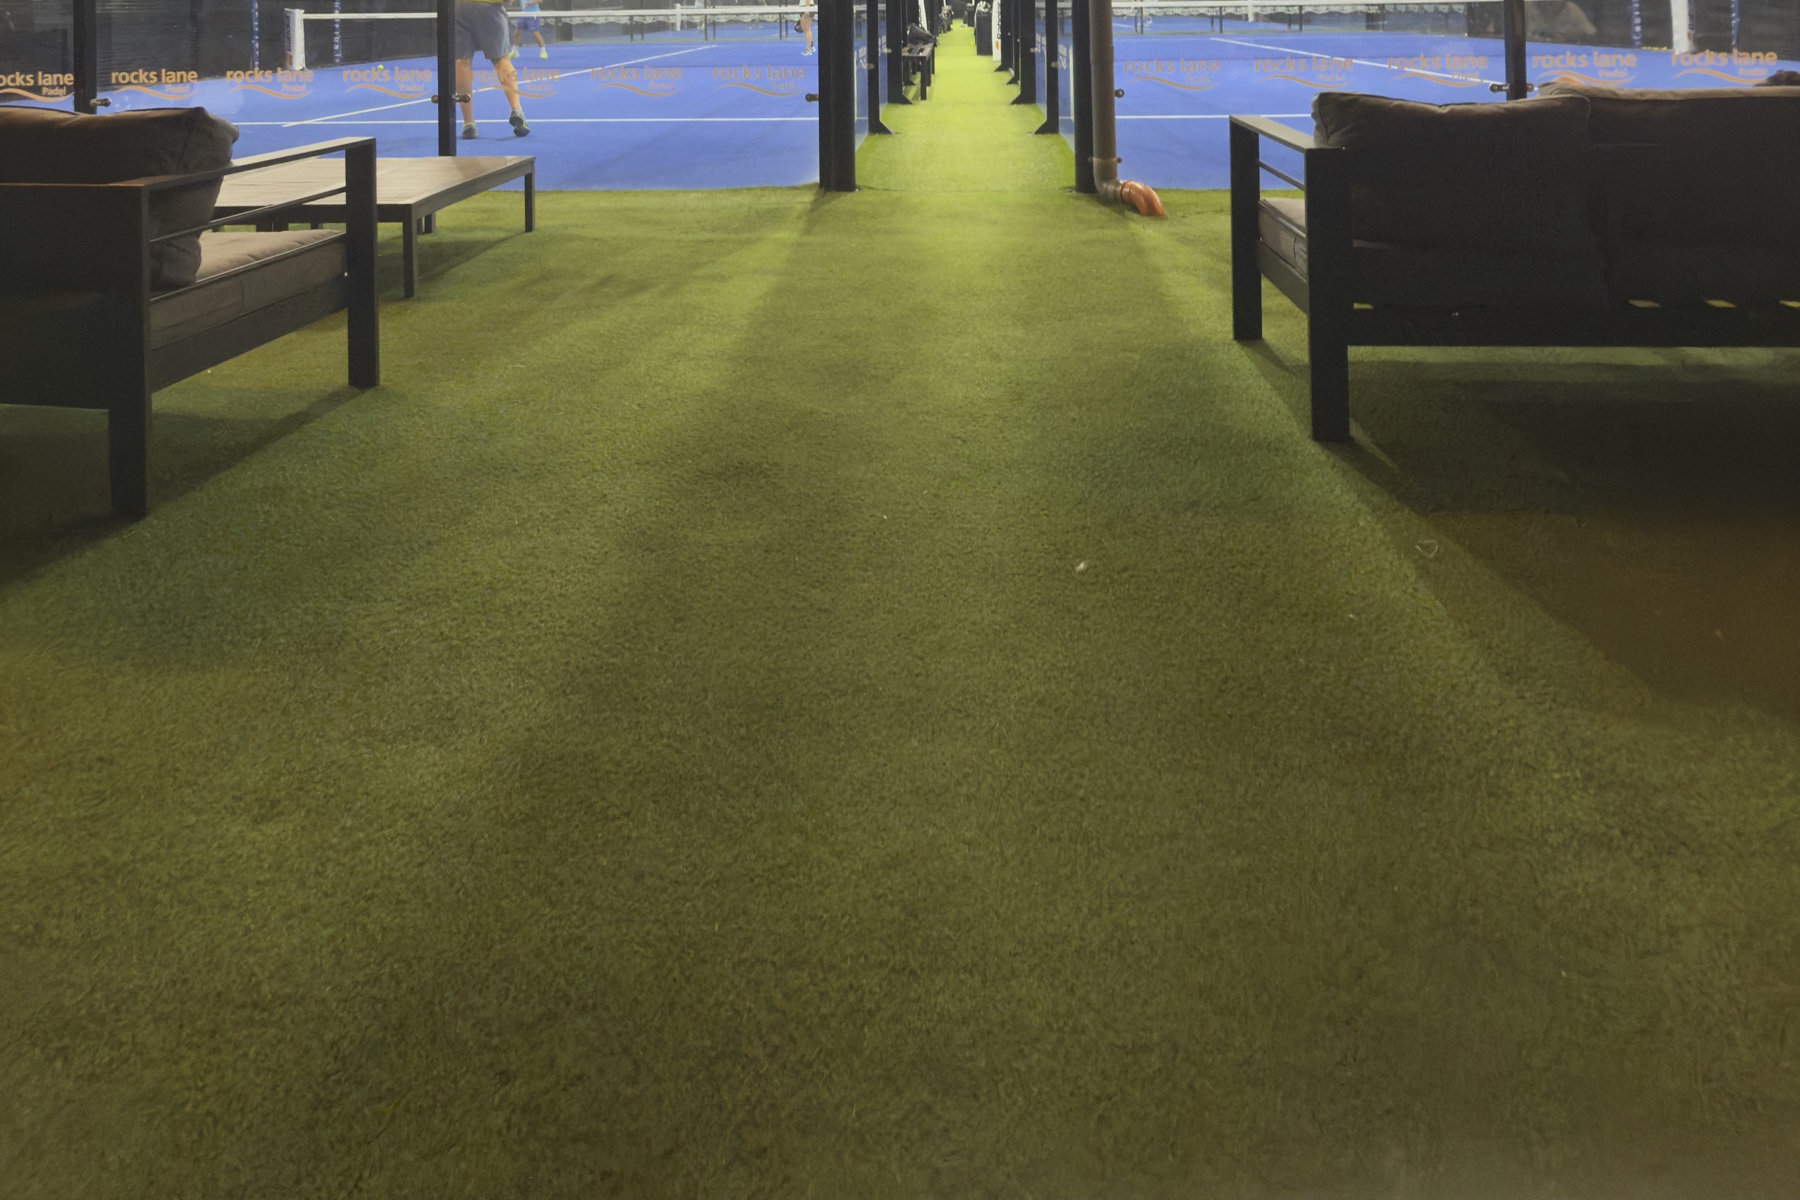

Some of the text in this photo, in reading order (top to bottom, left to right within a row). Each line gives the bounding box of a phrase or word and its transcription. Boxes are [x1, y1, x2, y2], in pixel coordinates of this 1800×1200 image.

[1123, 57, 1222, 74] rocks lane
[1254, 55, 1354, 73] rocks lane
[1387, 54, 1489, 70] rocks lane
[1533, 51, 1637, 68] rocks lane
[1672, 49, 1777, 66] rocks lane
[38, 71, 74, 86] lane
[111, 68, 198, 84] rocks lane
[226, 67, 314, 83] rocks lane
[343, 66, 432, 82] rocks lane
[591, 65, 683, 81] rocks lane
[713, 64, 806, 80] rocks lane
[42, 86, 67, 96] Padel
